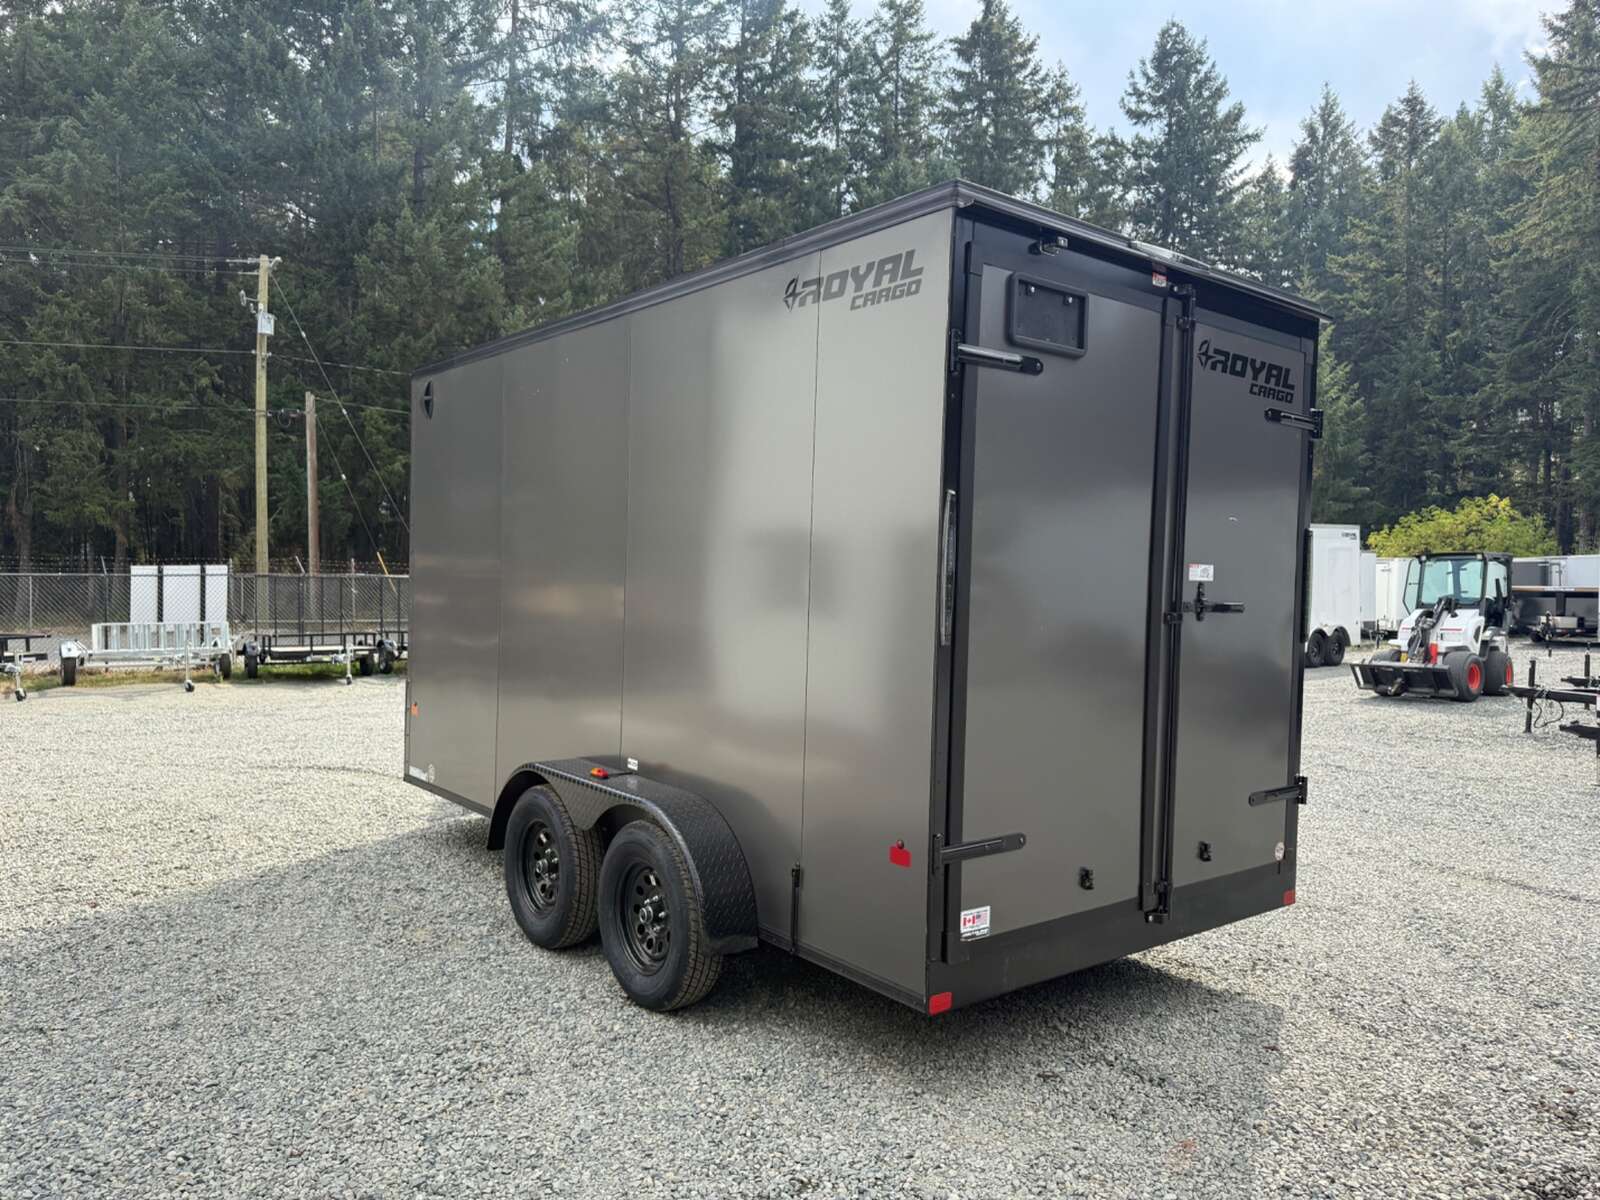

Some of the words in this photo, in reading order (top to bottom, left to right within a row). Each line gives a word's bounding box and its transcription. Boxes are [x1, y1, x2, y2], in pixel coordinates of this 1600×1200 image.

[799, 250, 924, 308] ROYAL
[850, 278, 922, 311] CARGO
[1209, 347, 1295, 391] ROYAL
[1249, 382, 1294, 404] CARGO
